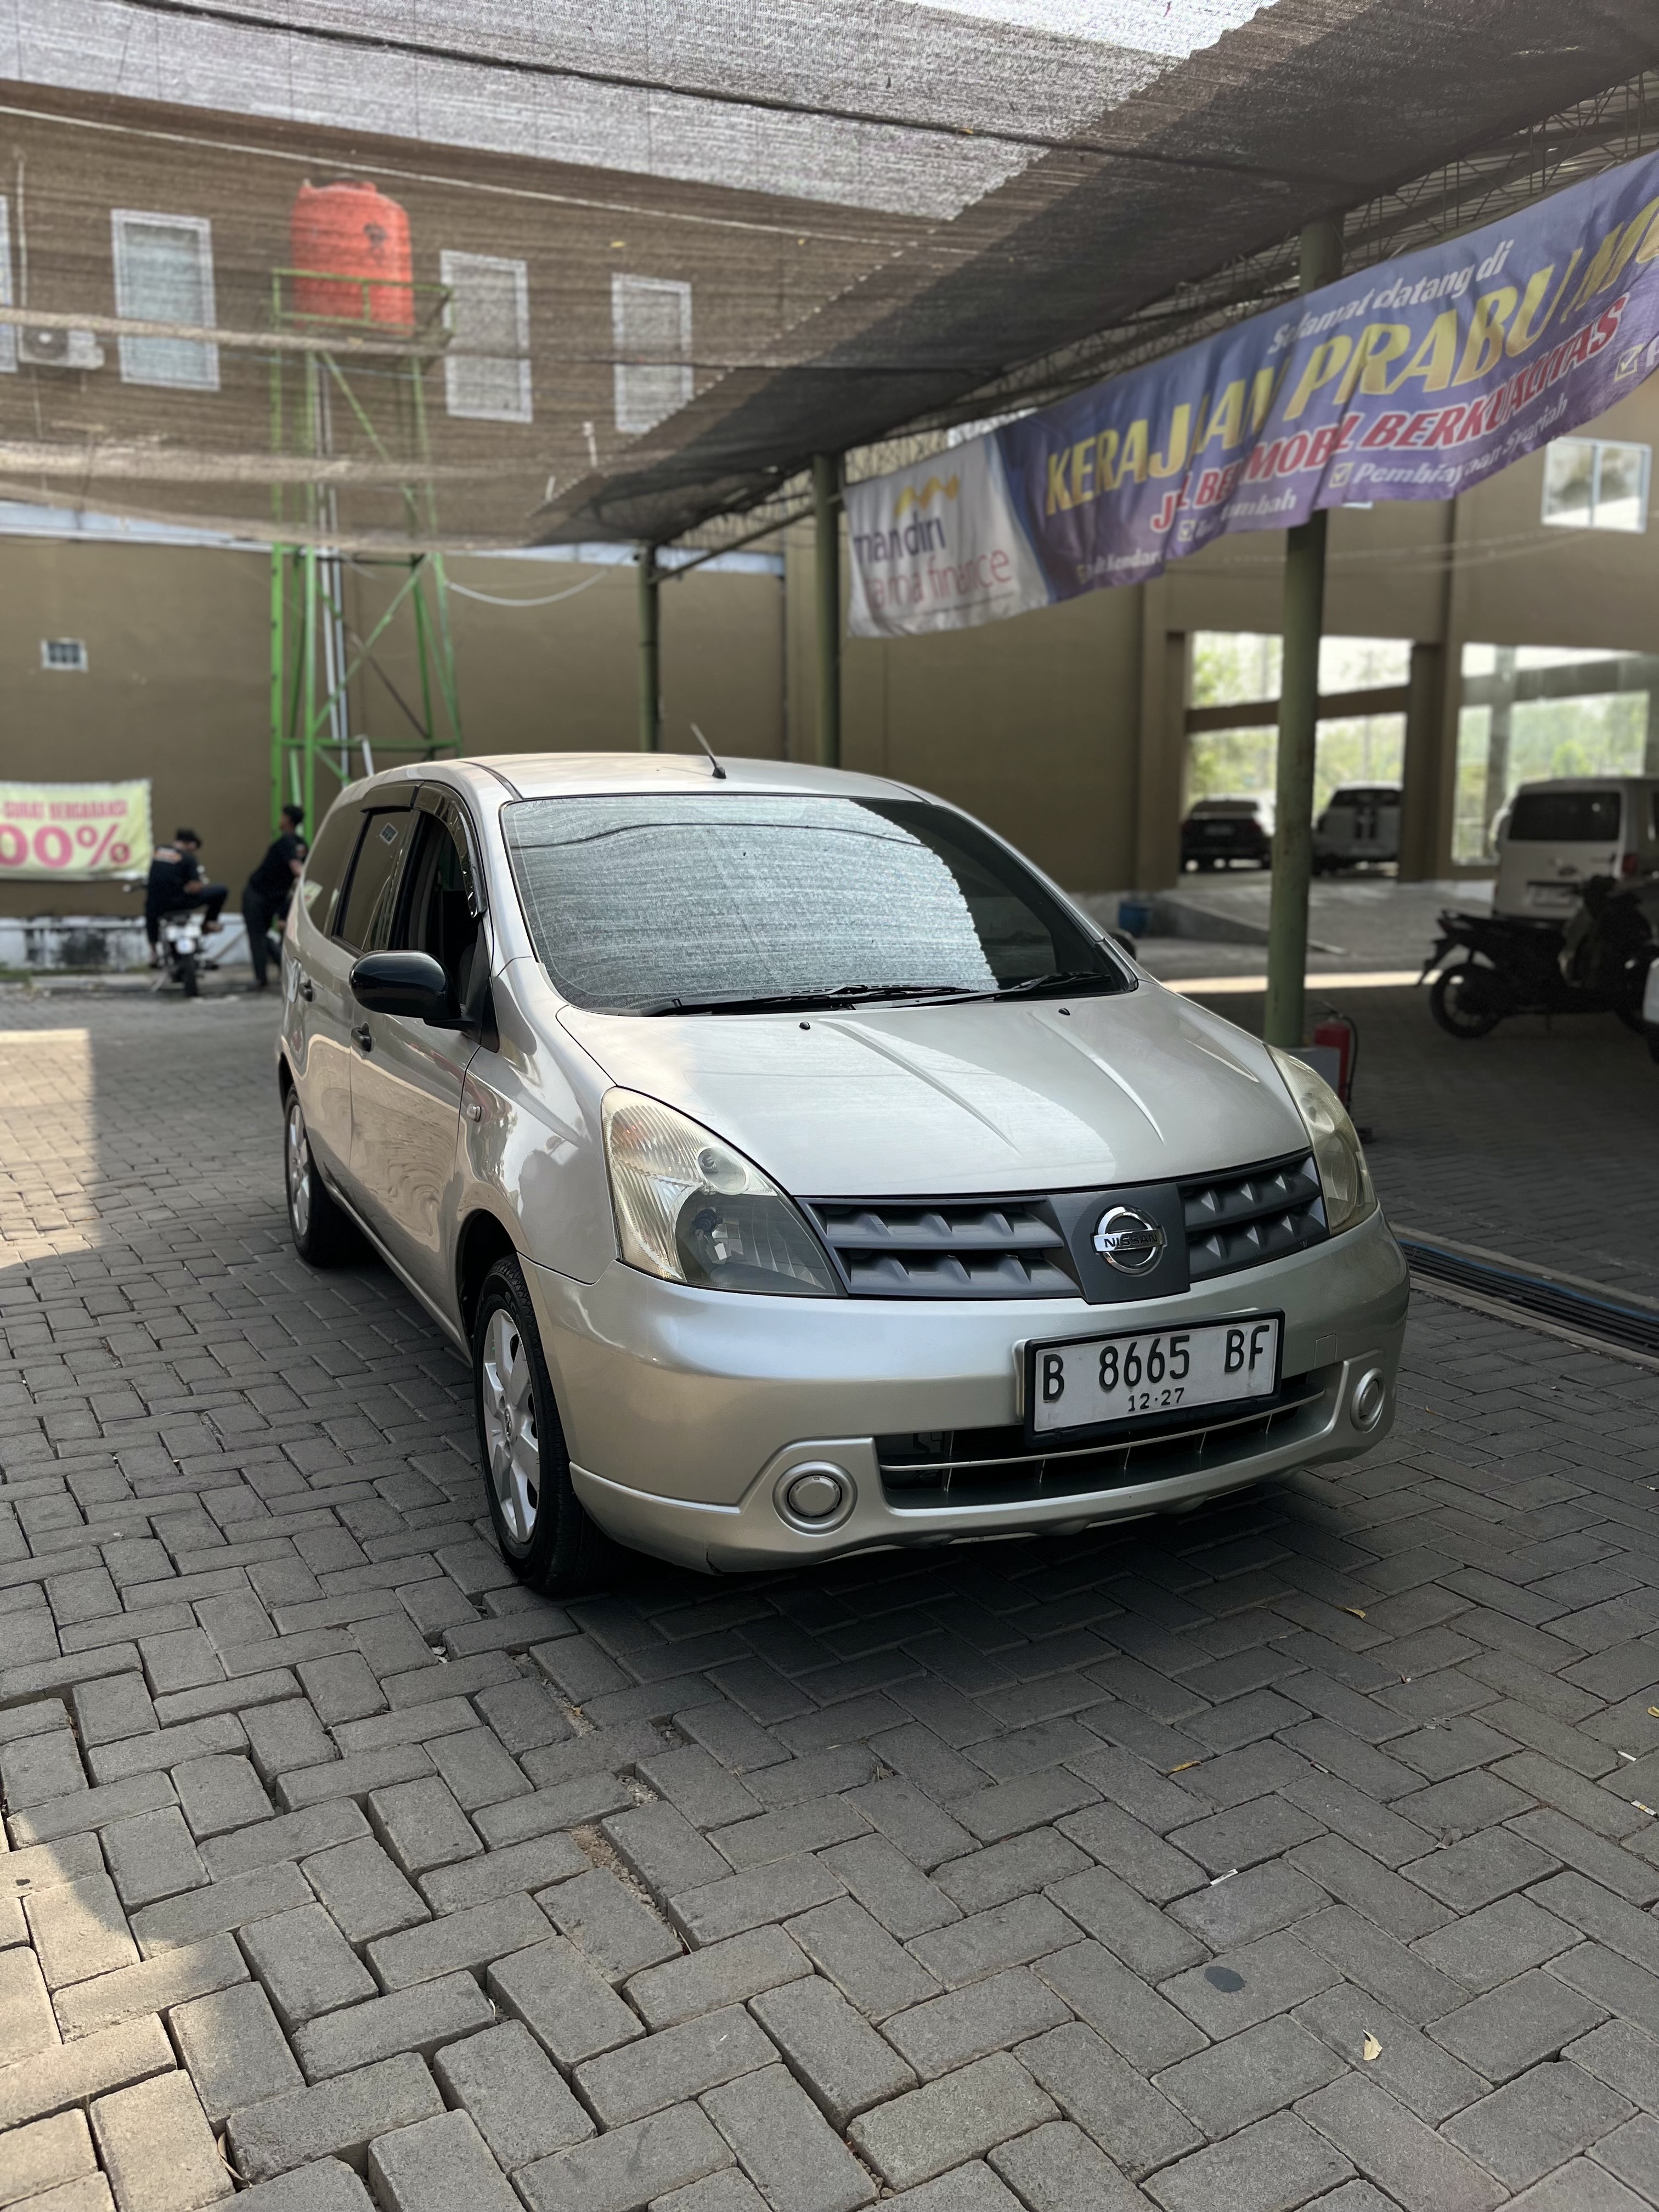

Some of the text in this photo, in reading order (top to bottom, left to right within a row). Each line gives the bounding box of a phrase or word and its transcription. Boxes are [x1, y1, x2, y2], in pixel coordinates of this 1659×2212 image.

[1267, 239, 1514, 354] Selamat datang di
[1283, 247, 1583, 421] PRABU
[1355, 292, 1630, 451] BERKUALITAS
[853, 511, 946, 564] mandiri
[1104, 1234, 1158, 1248] NISSAN
[1043, 1324, 1270, 1402] B 8665 BF
